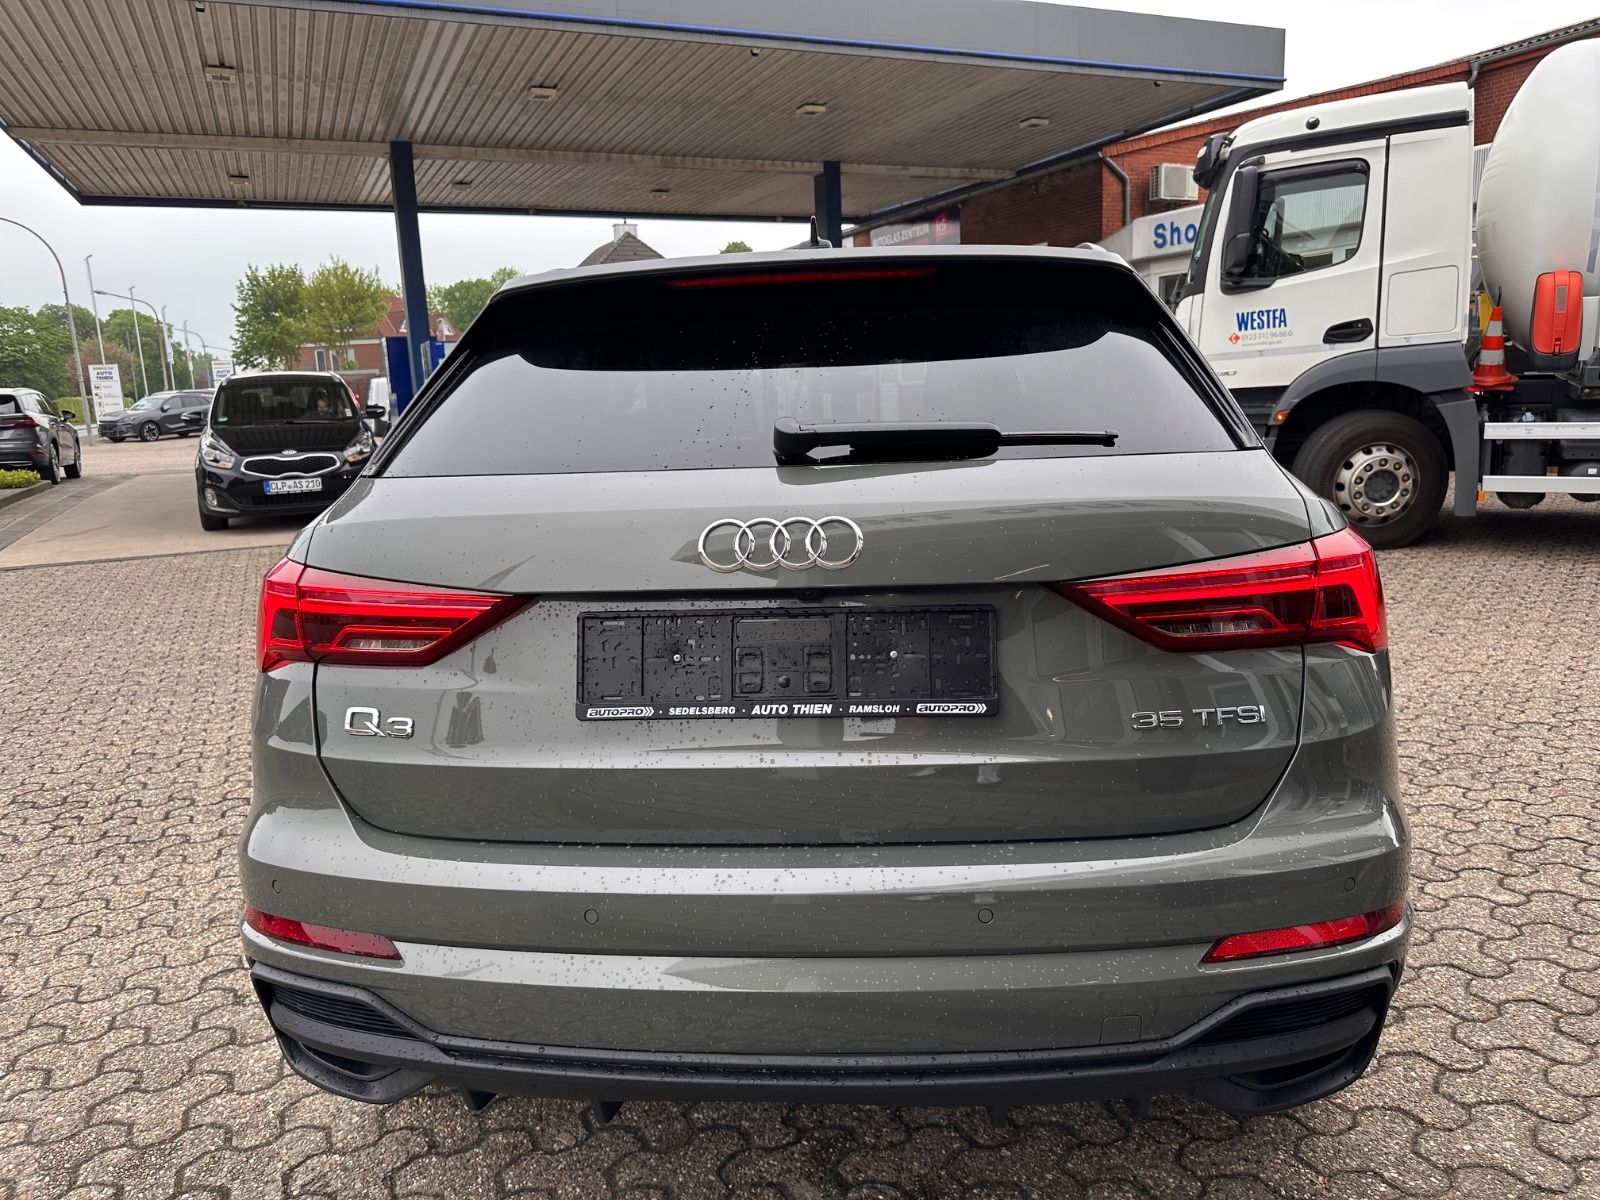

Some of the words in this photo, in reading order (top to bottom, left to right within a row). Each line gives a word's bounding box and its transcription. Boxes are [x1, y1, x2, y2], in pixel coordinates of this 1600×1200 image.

[901, 223, 930, 241] ZENTRUM
[1153, 221, 1198, 249] Sho
[1236, 308, 1288, 332] WESTFA
[270, 481, 287, 491] CLP
[293, 480, 304, 489] AS
[305, 479, 321, 489] 210
[668, 706, 736, 716] SEDELSBERG
[751, 704, 788, 715] AUTO
[793, 703, 833, 715] THIEN
[849, 704, 900, 714] RAMSLOH
[1131, 710, 1183, 730] 35
[1192, 705, 1266, 727] TFSI
[344, 706, 415, 739] Q3
